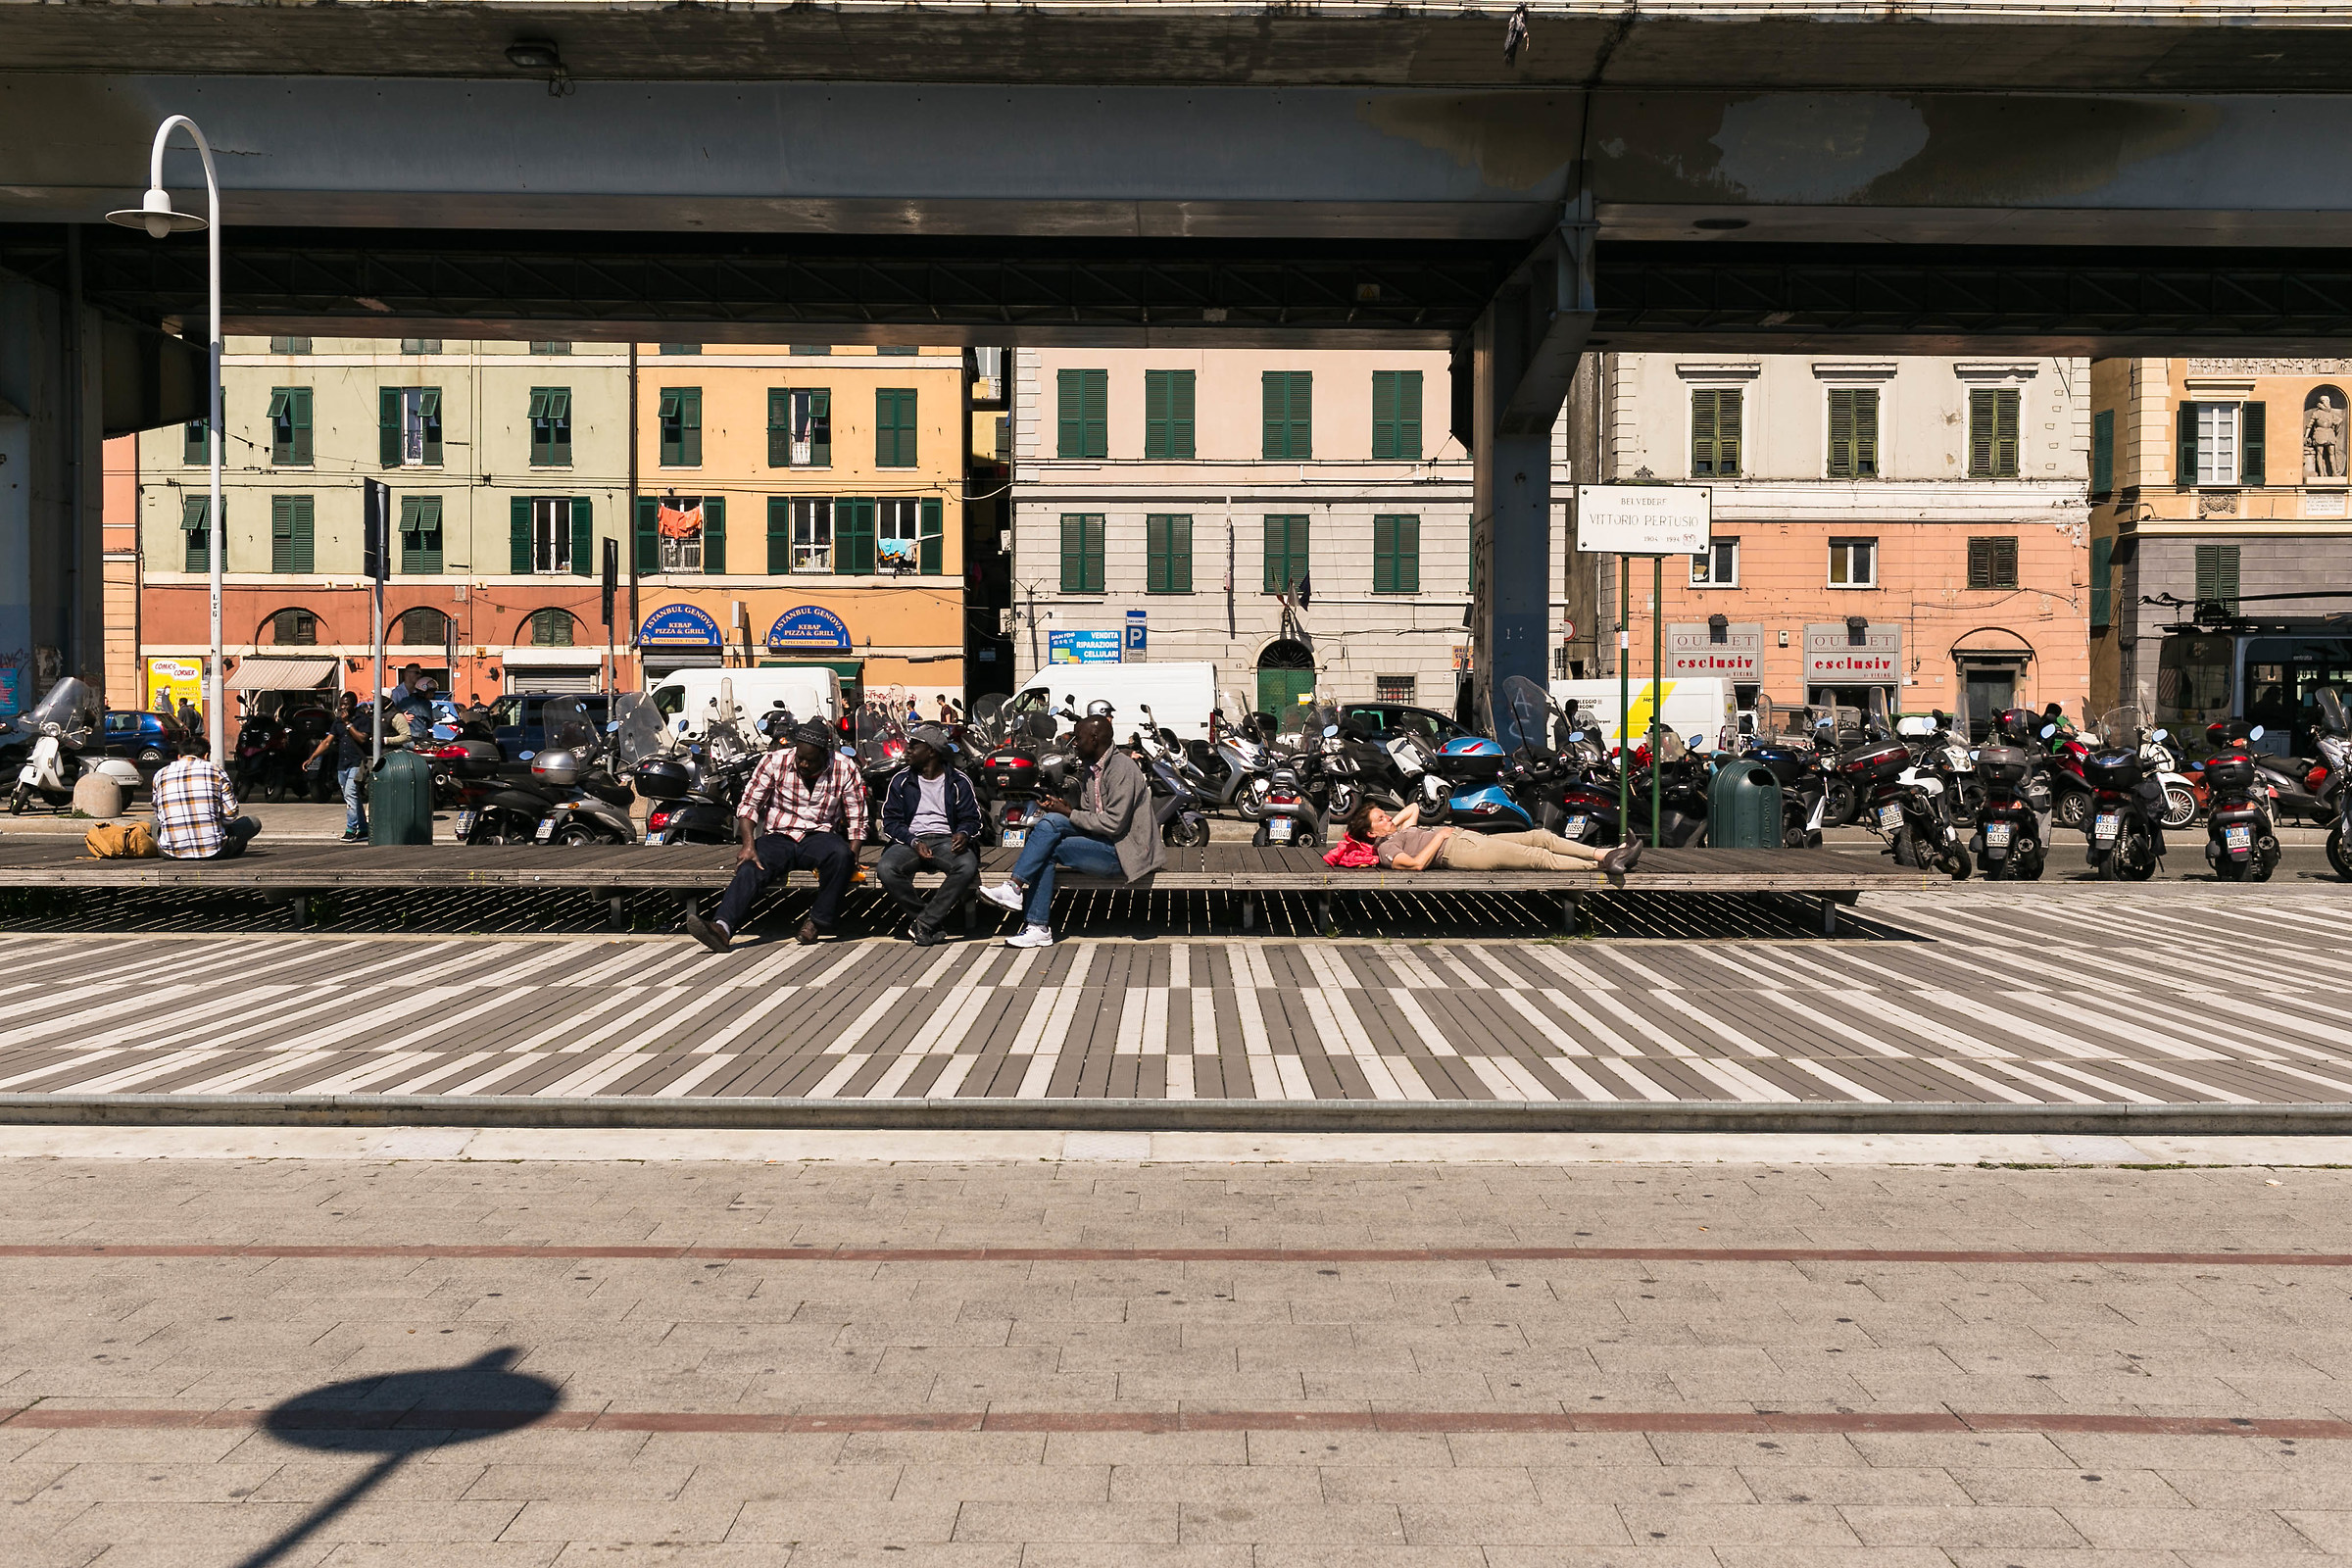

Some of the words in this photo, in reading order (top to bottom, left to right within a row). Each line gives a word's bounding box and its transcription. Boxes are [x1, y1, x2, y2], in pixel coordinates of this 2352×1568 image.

[1621, 497, 1667, 506] BELVEDERE
[1589, 514, 1639, 526] VITTORIO
[1644, 515, 1699, 527] PERTUSIO
[646, 606, 683, 629] ISTANBUL
[685, 607, 714, 630] GENOVA
[775, 608, 812, 631] ISTANBUL
[814, 608, 843, 632] GENOVA
[1130, 628, 1143, 646] P
[1677, 636, 1754, 646] OUTLET
[1815, 637, 1892, 646] OUTLET
[1677, 656, 1753, 668] esclusiv
[1815, 657, 1890, 669] esclusiv
[2097, 824, 2117, 832] 72313
[1988, 834, 2009, 842] 84125
